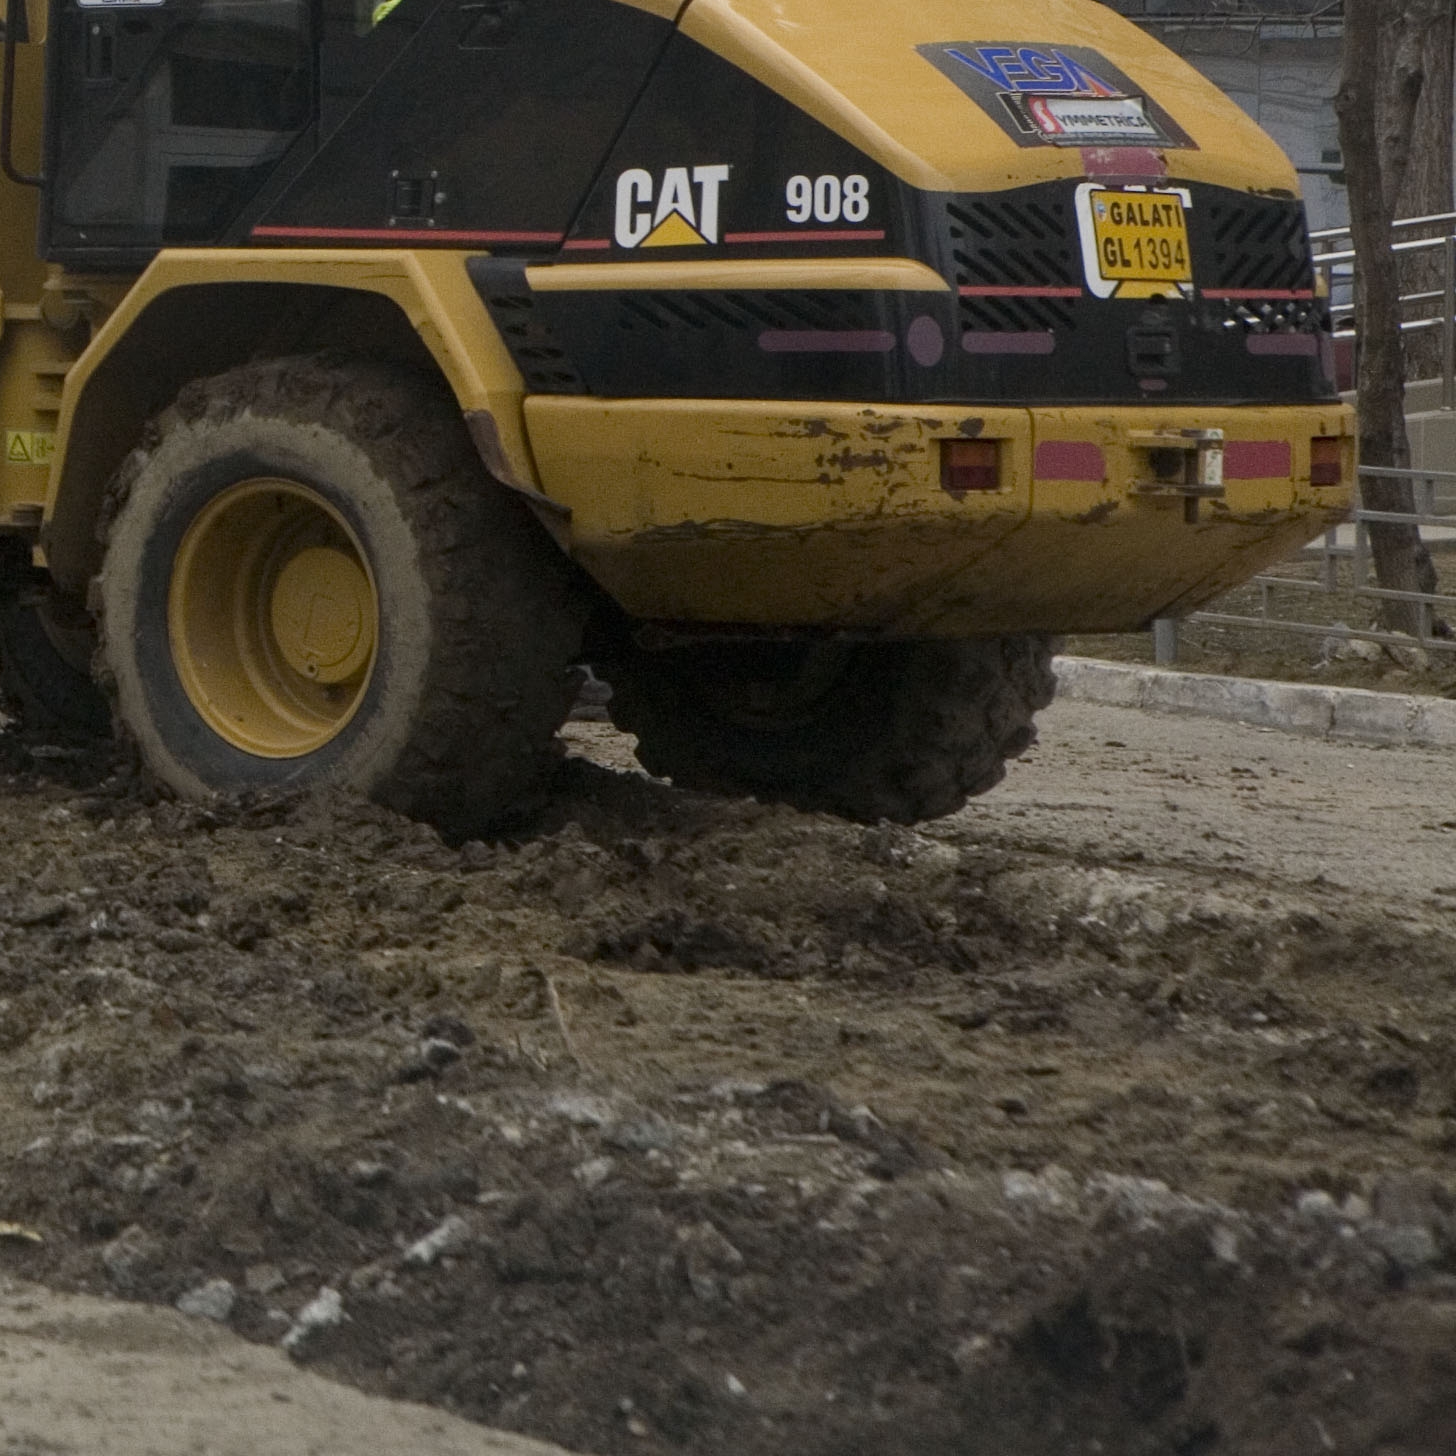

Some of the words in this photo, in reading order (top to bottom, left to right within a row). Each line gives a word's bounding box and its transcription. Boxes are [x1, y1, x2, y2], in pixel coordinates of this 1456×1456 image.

[944, 47, 1123, 94] VEGA
[614, 164, 729, 248] CAT
[786, 175, 869, 223] 908
[1110, 202, 1182, 228] GALATI
